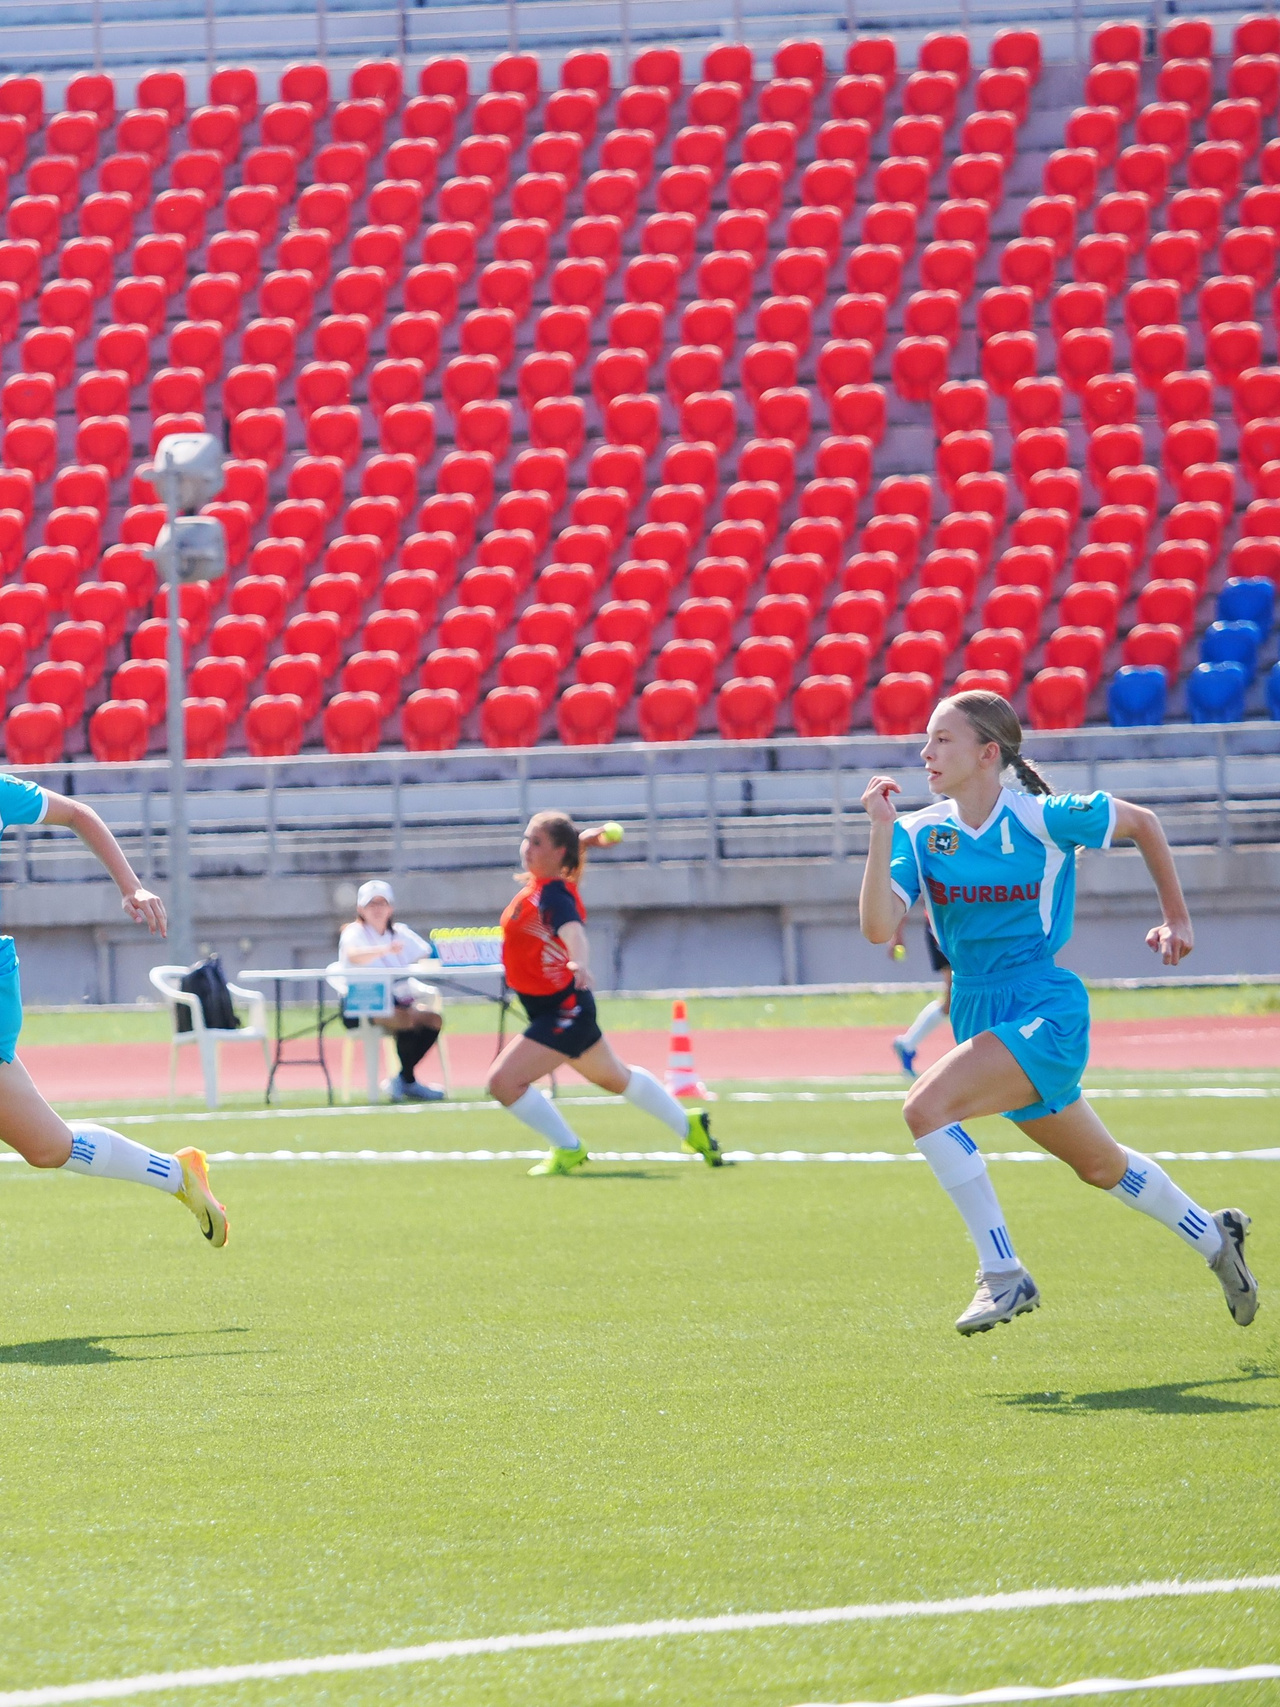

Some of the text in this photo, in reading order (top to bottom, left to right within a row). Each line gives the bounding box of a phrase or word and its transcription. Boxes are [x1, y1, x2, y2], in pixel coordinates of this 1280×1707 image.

[1000, 816, 1015, 855] 1
[949, 881, 1040, 904] FURBAU
[1018, 1016, 1045, 1039] 1
